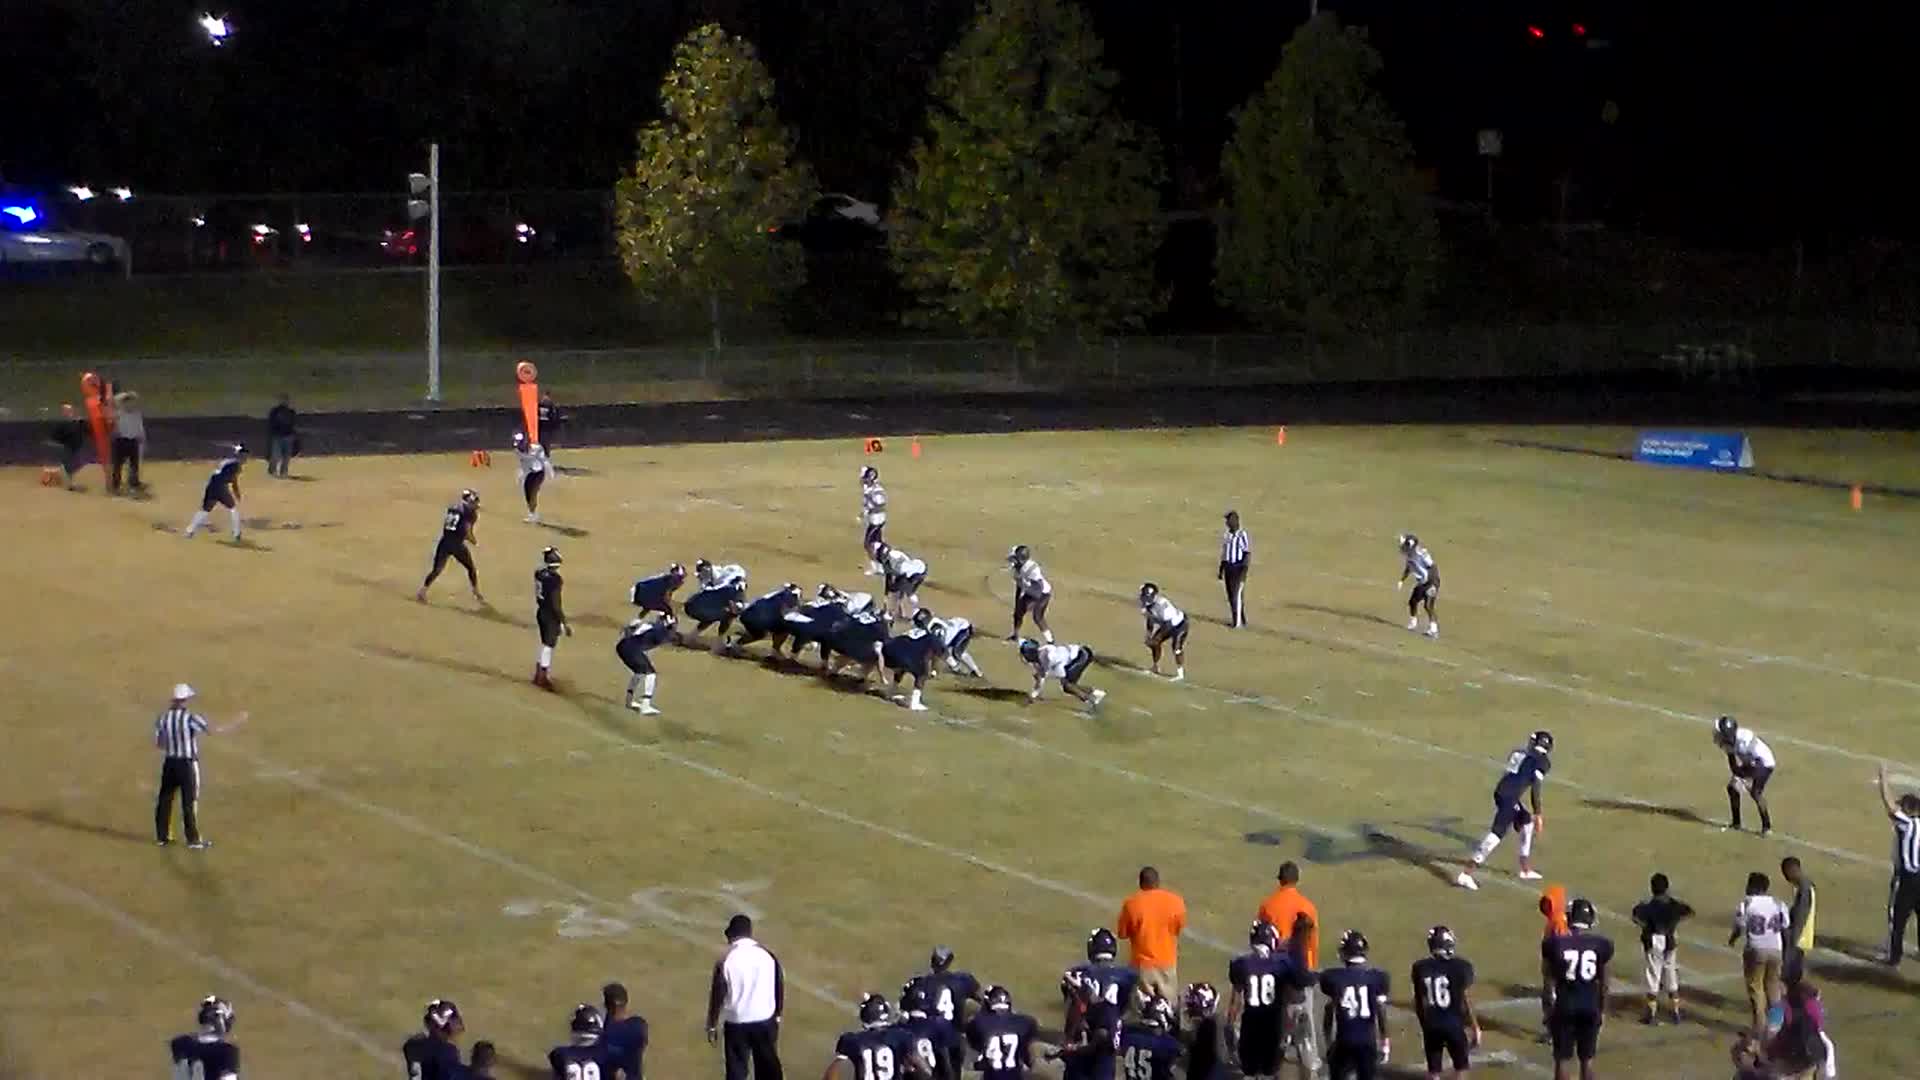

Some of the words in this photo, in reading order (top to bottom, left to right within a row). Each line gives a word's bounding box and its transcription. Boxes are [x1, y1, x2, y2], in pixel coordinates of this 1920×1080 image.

[1563, 949, 1598, 981] 76
[936, 988, 955, 1021] 4
[1248, 973, 1276, 1007] 18
[1340, 986, 1371, 1018] 41
[1424, 976, 1452, 1008] 16
[862, 1046, 895, 1080] 19
[986, 1034, 1019, 1070] 47
[1124, 1045, 1153, 1080] 45
